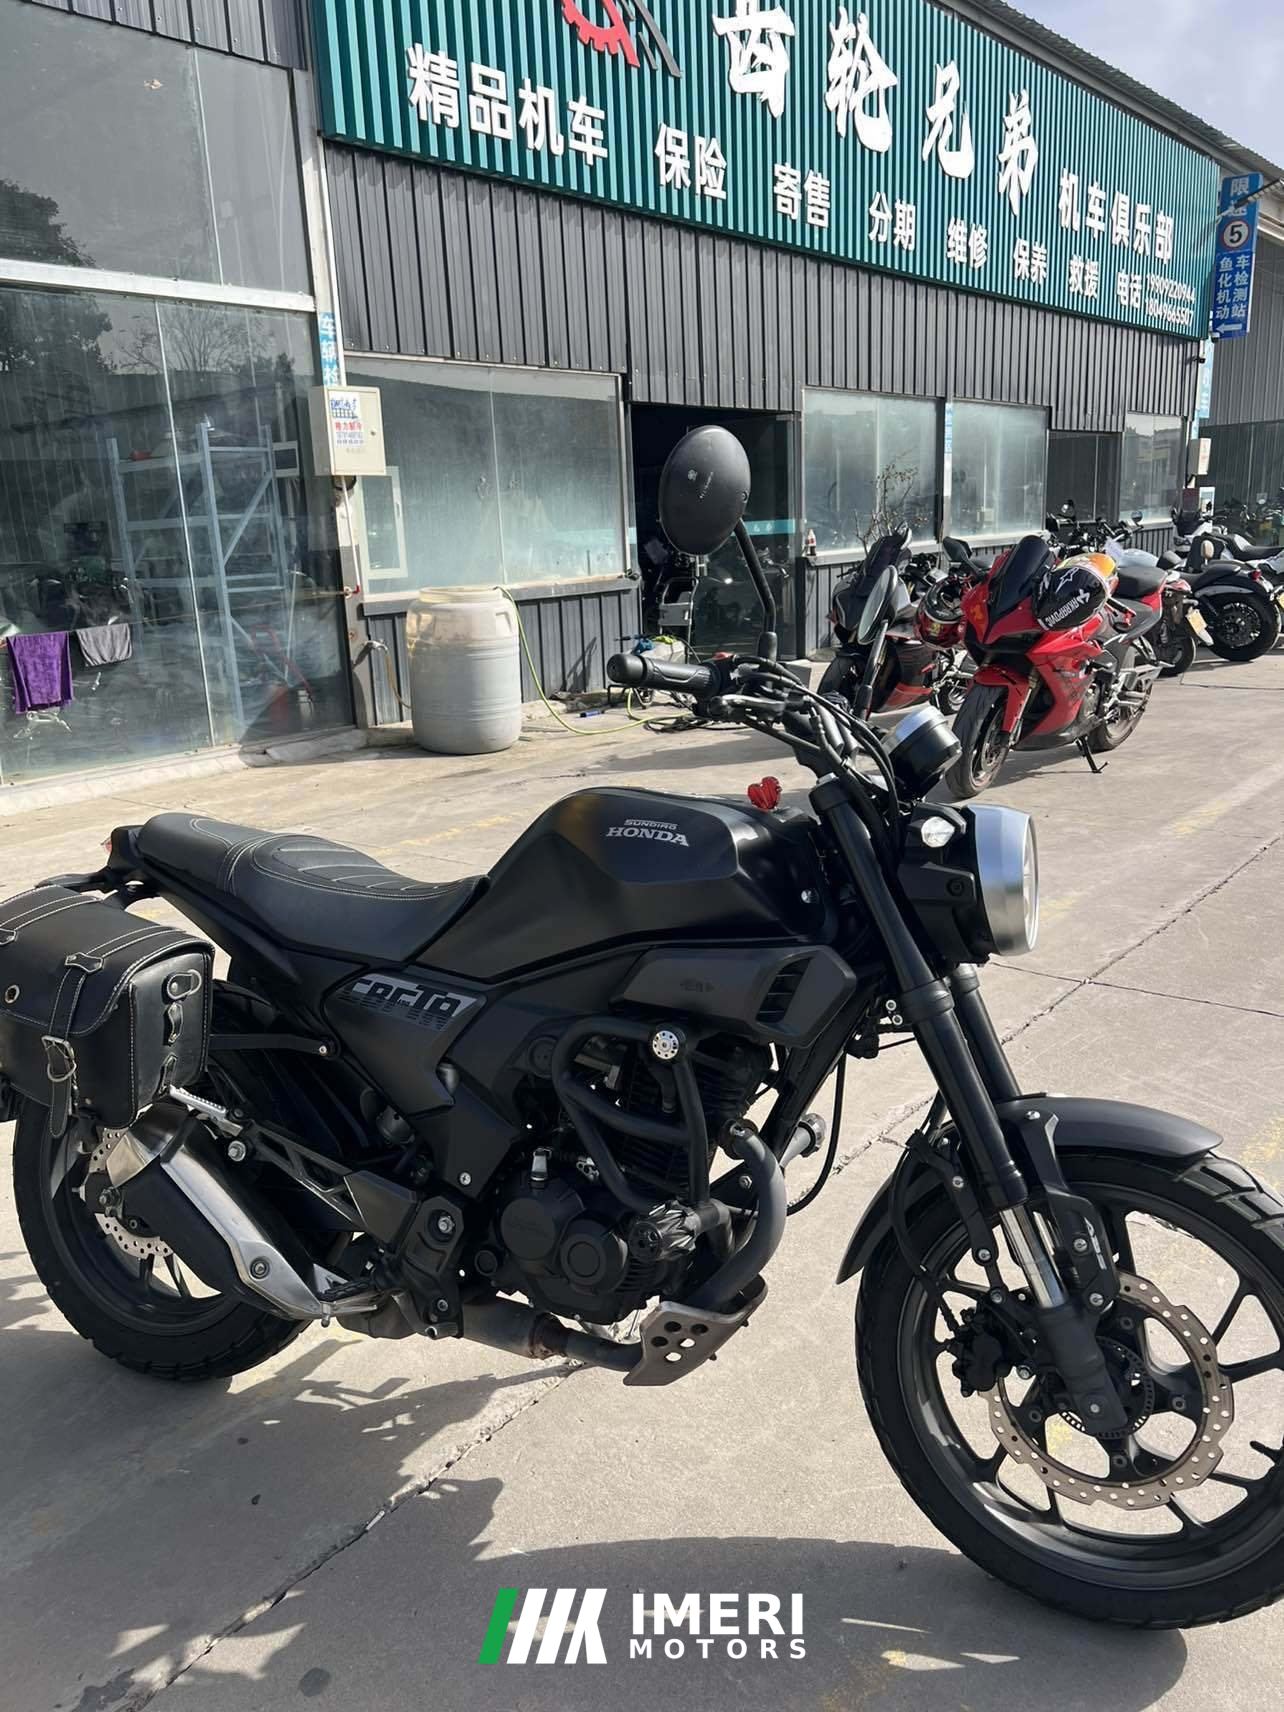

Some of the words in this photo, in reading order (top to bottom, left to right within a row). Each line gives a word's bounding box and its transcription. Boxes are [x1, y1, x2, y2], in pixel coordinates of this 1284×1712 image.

[407, 42, 608, 165] 精品机车
[655, 122, 727, 200] 保险
[773, 162, 832, 229] 寄售
[868, 192, 916, 251] 分期
[946, 217, 989, 268] 维修
[1013, 238, 1048, 284] 保养
[1068, 254, 1100, 300] 救援
[1116, 268, 1142, 309] 电话
[1058, 168, 1174, 265] 机车俱乐部
[1229, 224, 1243, 244] 5
[1215, 256, 1234, 320] 鱼化机动
[1231, 254, 1250, 318] 车检测站
[606, 826, 689, 847] HONDA
